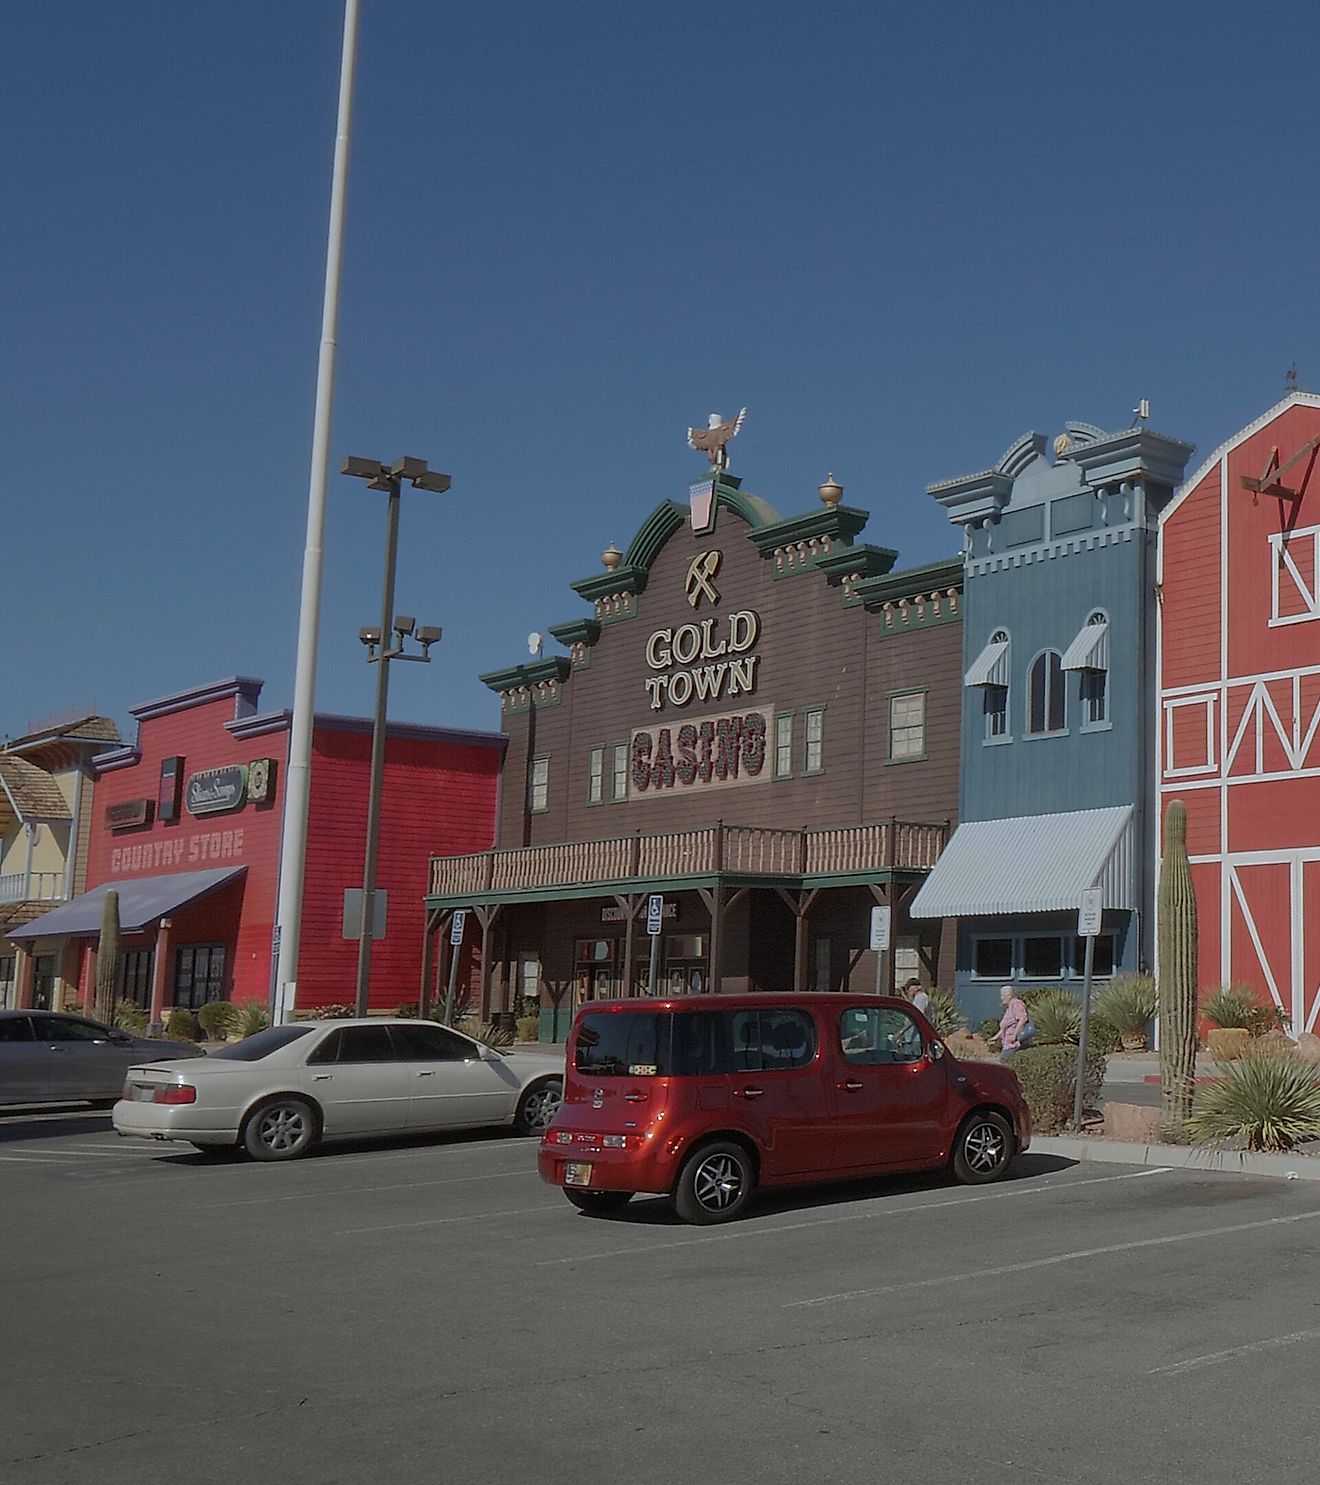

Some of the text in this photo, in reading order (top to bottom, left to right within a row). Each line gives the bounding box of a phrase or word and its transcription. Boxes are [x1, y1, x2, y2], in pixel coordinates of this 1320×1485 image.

[646, 609, 760, 670] GOLD
[646, 656, 759, 710] TOWN
[631, 712, 766, 792] CASINO
[111, 829, 244, 873] COUNTRY STORE
